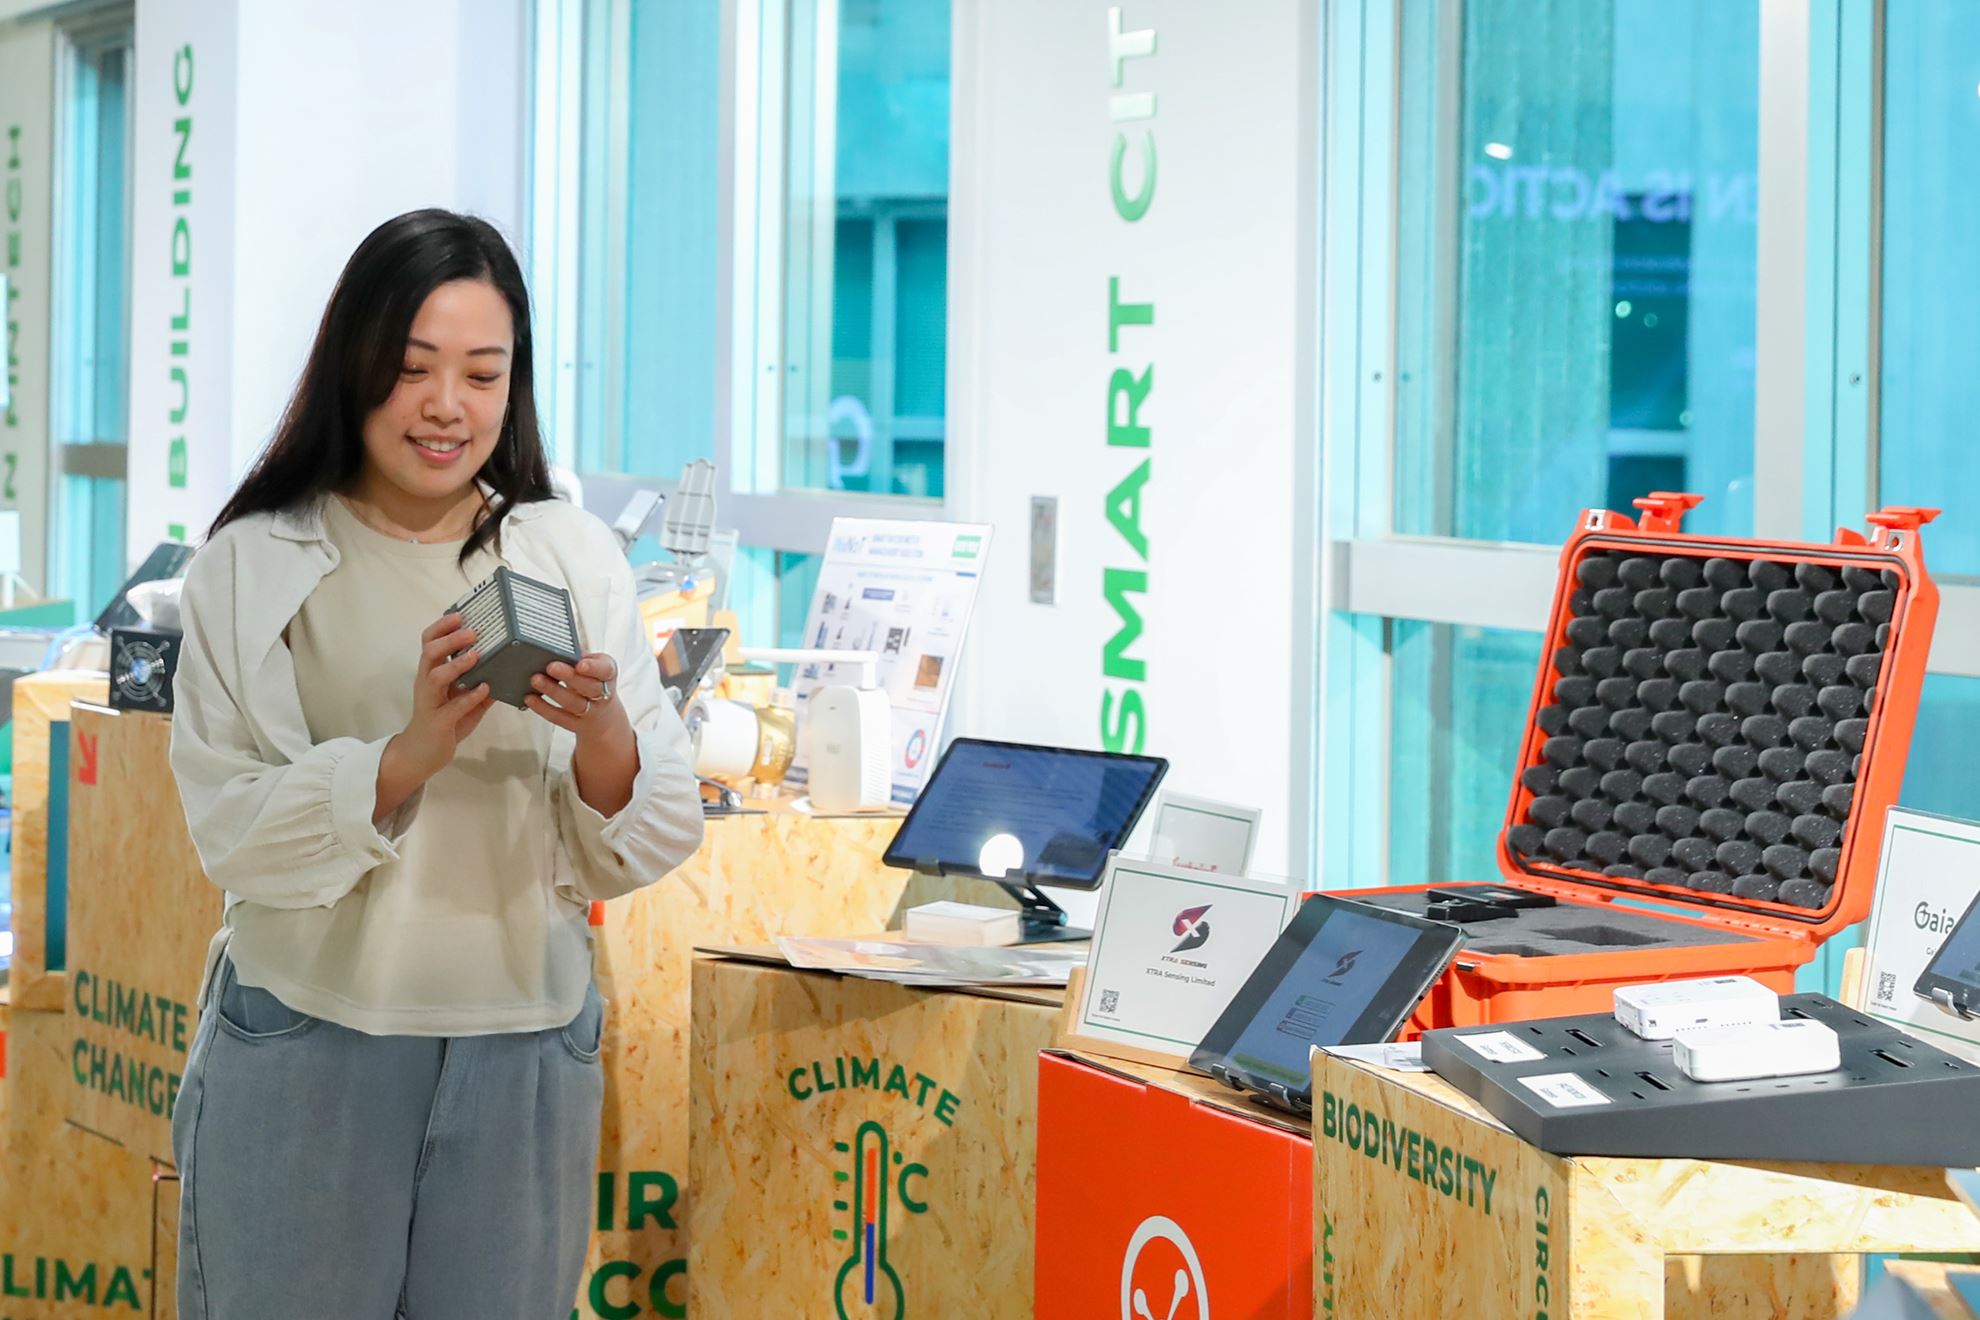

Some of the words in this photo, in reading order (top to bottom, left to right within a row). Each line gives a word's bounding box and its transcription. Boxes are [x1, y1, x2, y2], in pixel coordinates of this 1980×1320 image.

[168, 42, 194, 488] BUILDING
[1100, 276, 1154, 756] SMART
[75, 969, 188, 1053] CLIMATE
[1145, 968, 1163, 976] XTRA
[1164, 971, 1190, 983] Sensing
[1191, 976, 1216, 986] Limited
[72, 1038, 181, 1120] CHANGE
[788, 1056, 961, 1127] CLIMATE
[1322, 1091, 1497, 1216] BIODIVERSITY
